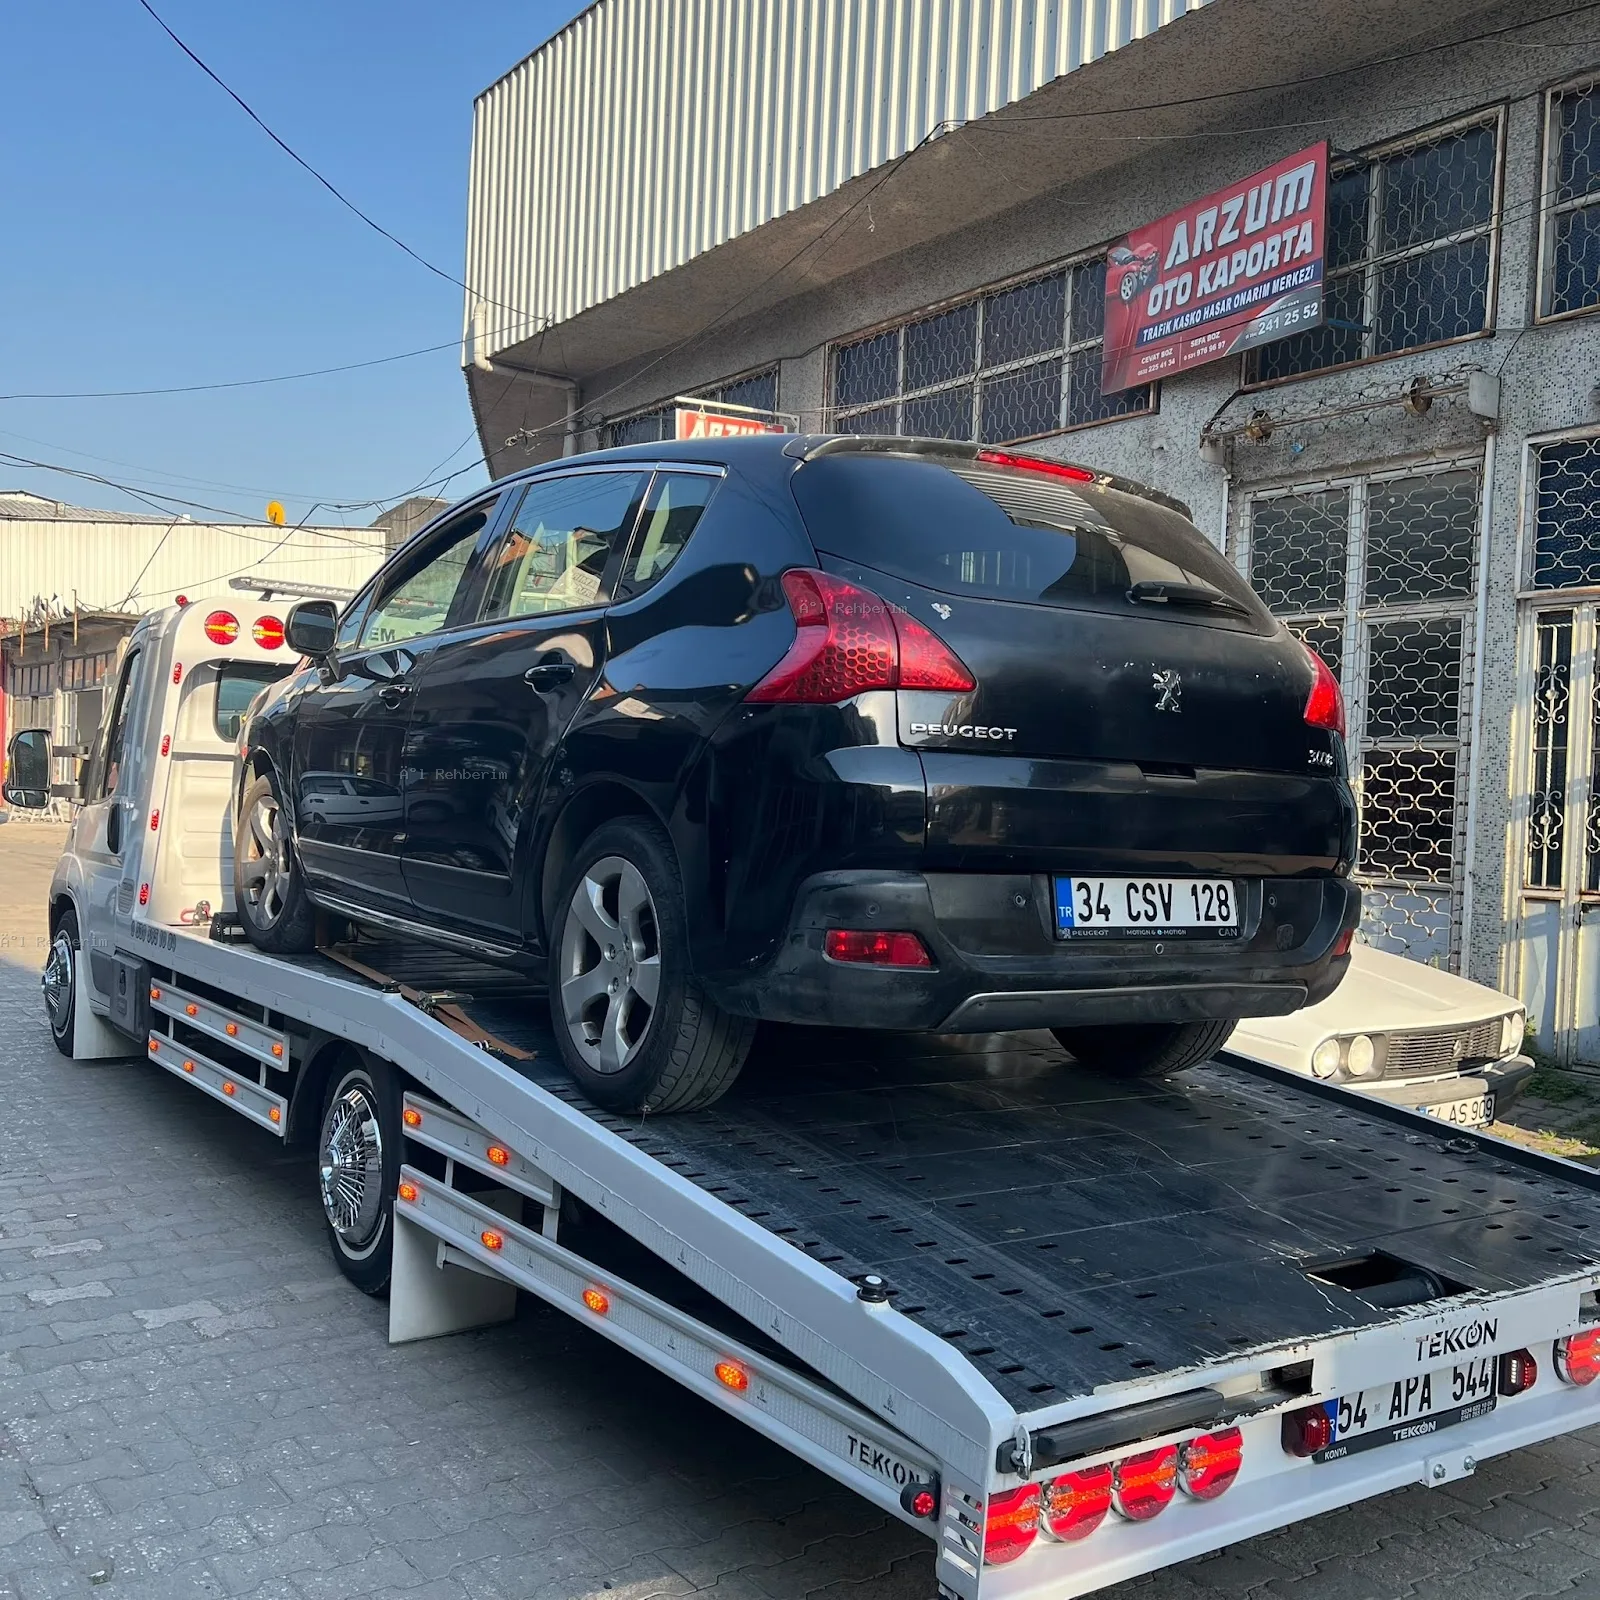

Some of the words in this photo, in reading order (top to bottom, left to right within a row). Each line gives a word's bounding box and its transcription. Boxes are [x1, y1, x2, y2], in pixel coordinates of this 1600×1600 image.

[1164, 160, 1316, 271] ARZUM
[1147, 272, 1193, 316] OTO
[1197, 219, 1313, 297] KAPORTA
[1173, 311, 1201, 331] KASKO
[1203, 300, 1231, 320] HASAR
[1234, 287, 1270, 308] ONARIM
[1258, 316, 1279, 335] 241
[1284, 309, 1300, 326] 25
[1303, 302, 1318, 319] 52
[1190, 336, 1206, 347] SEFA
[1141, 352, 1160, 364] CEVAT
[1148, 363, 1159, 373] 225
[1160, 360, 1167, 368] 41
[1168, 358, 1175, 366] 34
[910, 723, 1018, 740] PEUGEOT
[1059, 907, 1073, 918] TR
[1076, 882, 1111, 922] 34
[1126, 882, 1172, 922] CSV
[1191, 884, 1231, 922] 128
[1218, 928, 1238, 937] CAN
[1449, 1103, 1468, 1124] AS
[1471, 1098, 1493, 1120] 909
[1416, 1318, 1498, 1361] TEKKON
[1338, 1391, 1367, 1433] 54
[1389, 1373, 1431, 1420] APA
[1452, 1359, 1489, 1401] 544
[1393, 1421, 1437, 1441] TEKKON
[1324, 1447, 1348, 1460] KONYA
